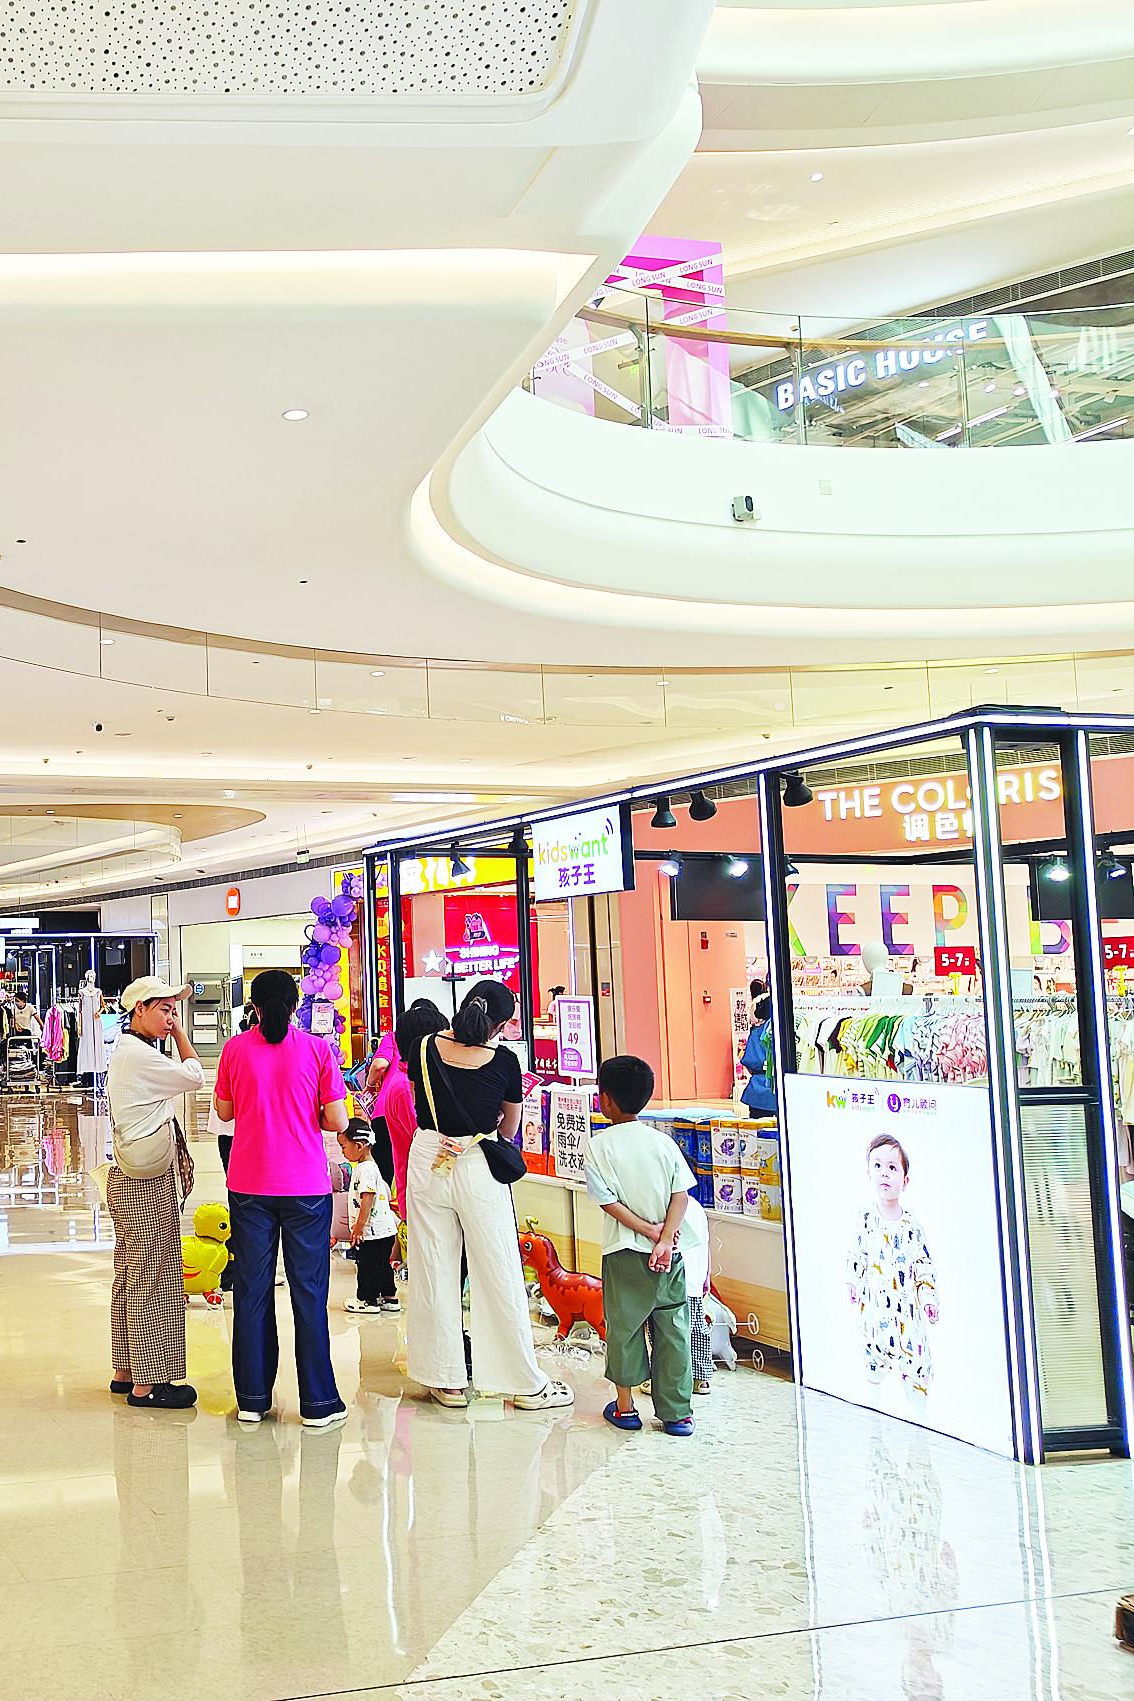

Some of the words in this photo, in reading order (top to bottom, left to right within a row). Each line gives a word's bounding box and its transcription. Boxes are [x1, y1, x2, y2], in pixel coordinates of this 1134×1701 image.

[679, 262, 698, 273] LONG
[699, 258, 713, 268] SUN
[632, 275, 651, 286] LONG
[652, 272, 666, 281] SUN
[686, 282, 706, 291] LONG
[708, 284, 722, 294] SUN
[679, 313, 698, 324] LONG
[699, 309, 713, 318] SUN
[584, 343, 603, 354] LONG
[604, 338, 618, 349] SUN
[555, 354, 570, 363] SUN
[584, 374, 602, 392] LONG
[603, 386, 618, 400] SUN
[776, 358, 866, 411] BASIC
[817, 786, 882, 821] THE
[891, 770, 1061, 814] COLRIS
[538, 833, 608, 865] kidswant
[558, 863, 596, 888] 孩子王
[459, 944, 499, 959] SHINING
[454, 960, 493, 974] BETTER
[494, 958, 515, 970] LIFE
[567, 1032, 579, 1044] 49
[852, 1093, 875, 1104] 孩子王
[903, 1098, 937, 1110] 育儿顾问
[852, 1104, 876, 1112] kidswant
[557, 1112, 586, 1132] 免费送
[558, 1132, 581, 1150] 雨伞/
